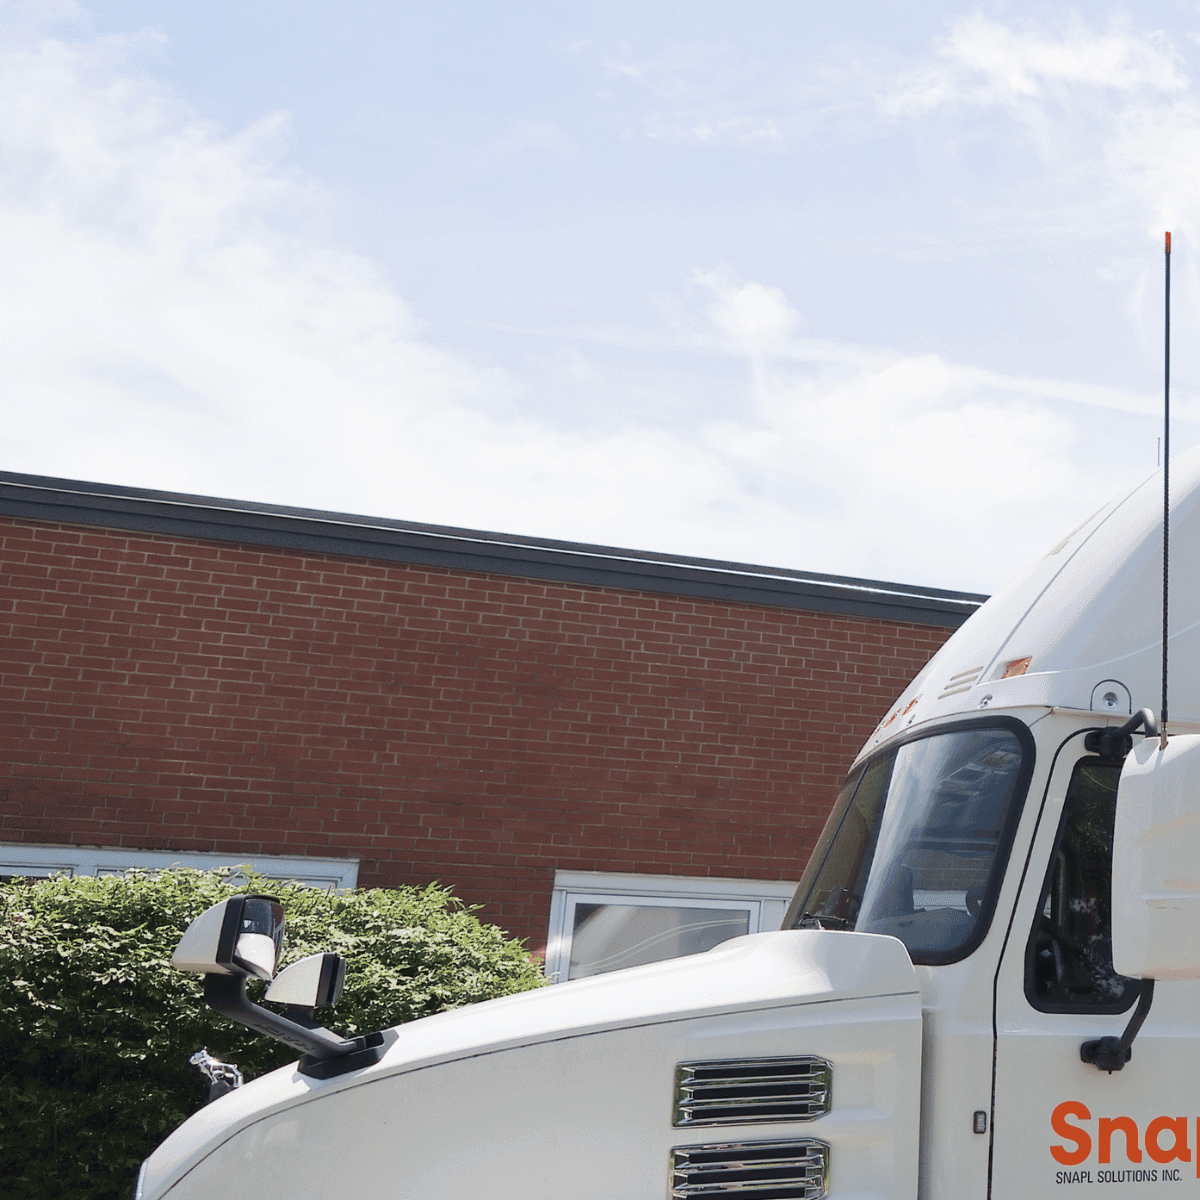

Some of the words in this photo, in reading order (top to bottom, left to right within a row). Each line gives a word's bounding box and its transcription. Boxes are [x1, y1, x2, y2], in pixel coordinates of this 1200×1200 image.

[1056, 1171, 1094, 1184] SNAPL
[1097, 1170, 1158, 1183] SOLUTIONS
[1161, 1169, 1182, 1182] INC.
